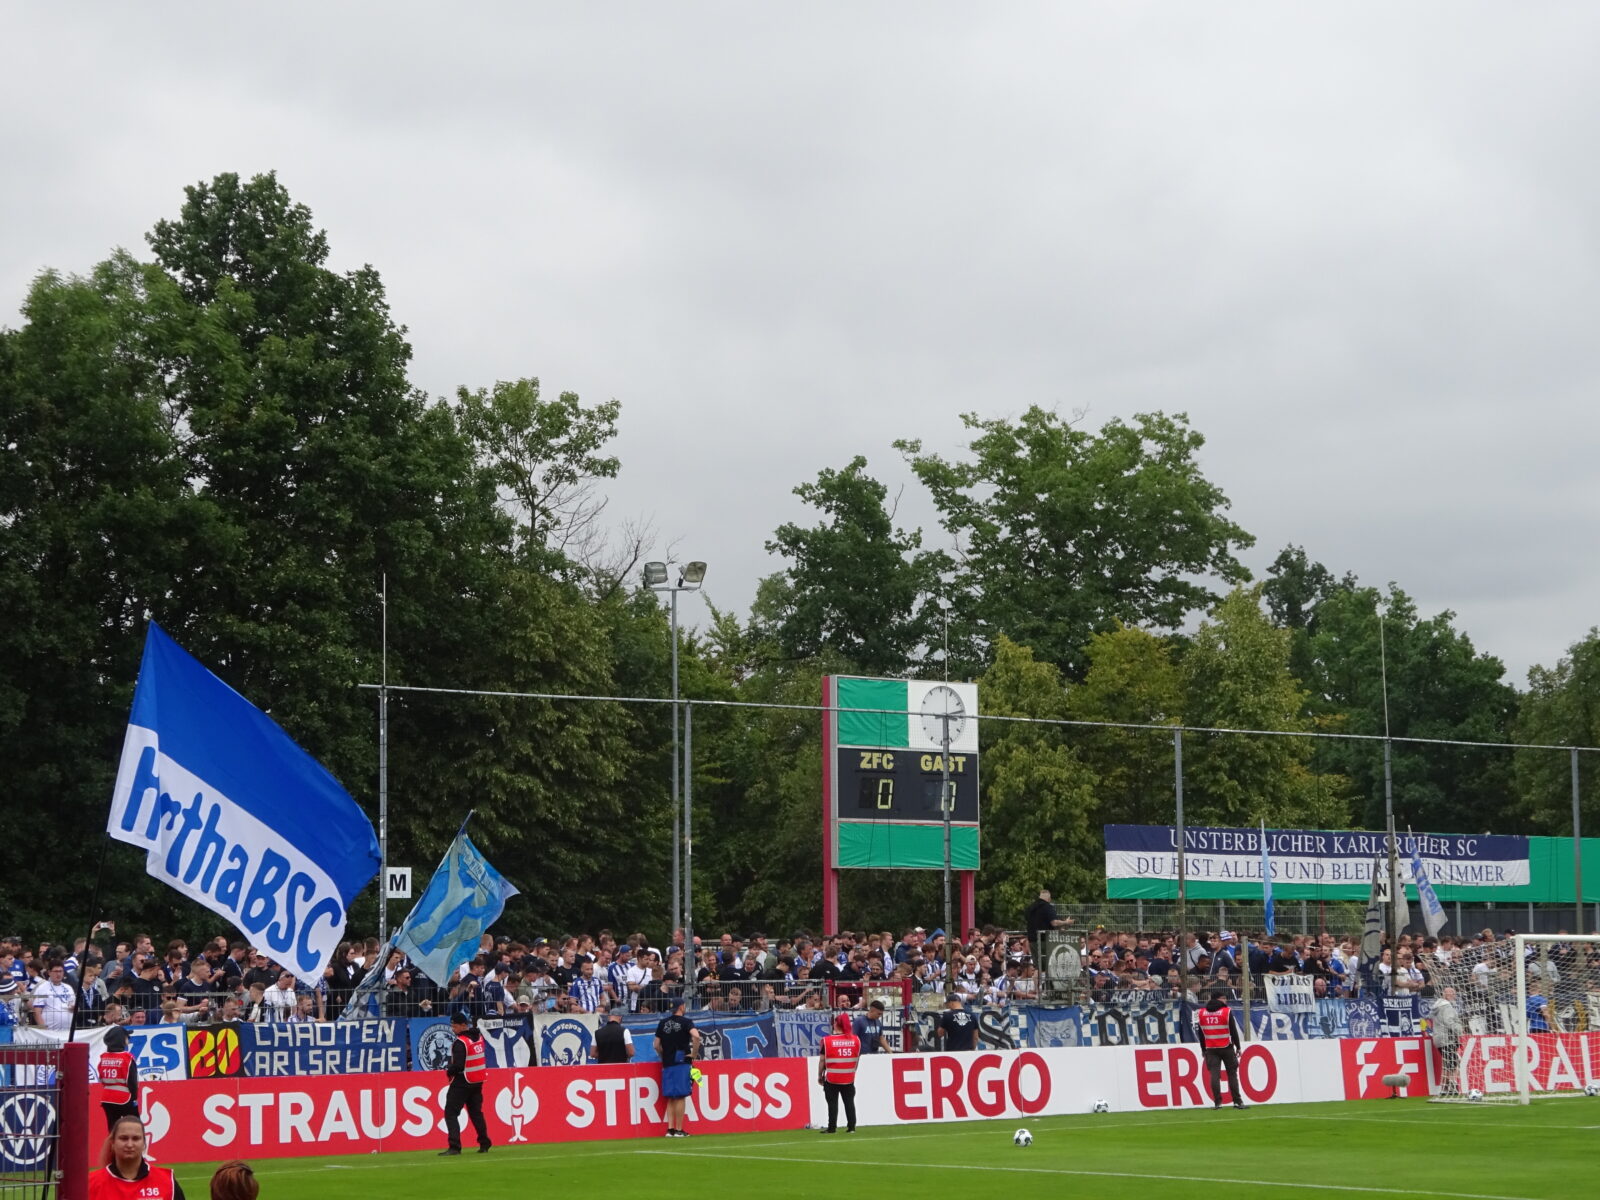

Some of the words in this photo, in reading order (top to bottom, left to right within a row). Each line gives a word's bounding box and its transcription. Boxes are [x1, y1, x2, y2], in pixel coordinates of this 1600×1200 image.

[859, 752, 895, 769] ZFC
[1457, 838, 1478, 857] SC
[1137, 857, 1163, 874] DU
[1285, 861, 1325, 880] UND
[1450, 863, 1504, 883] IMMER
[389, 873, 406, 892] M
[1377, 883, 1387, 897] N
[1206, 1016, 1219, 1024] 173
[254, 1019, 396, 1047] CHAOTEN
[780, 1022, 832, 1046] UNS
[837, 1048, 852, 1057] 155
[102, 1068, 118, 1078] 119
[892, 1052, 1051, 1120] ERGO
[140, 1187, 160, 1197] 136
